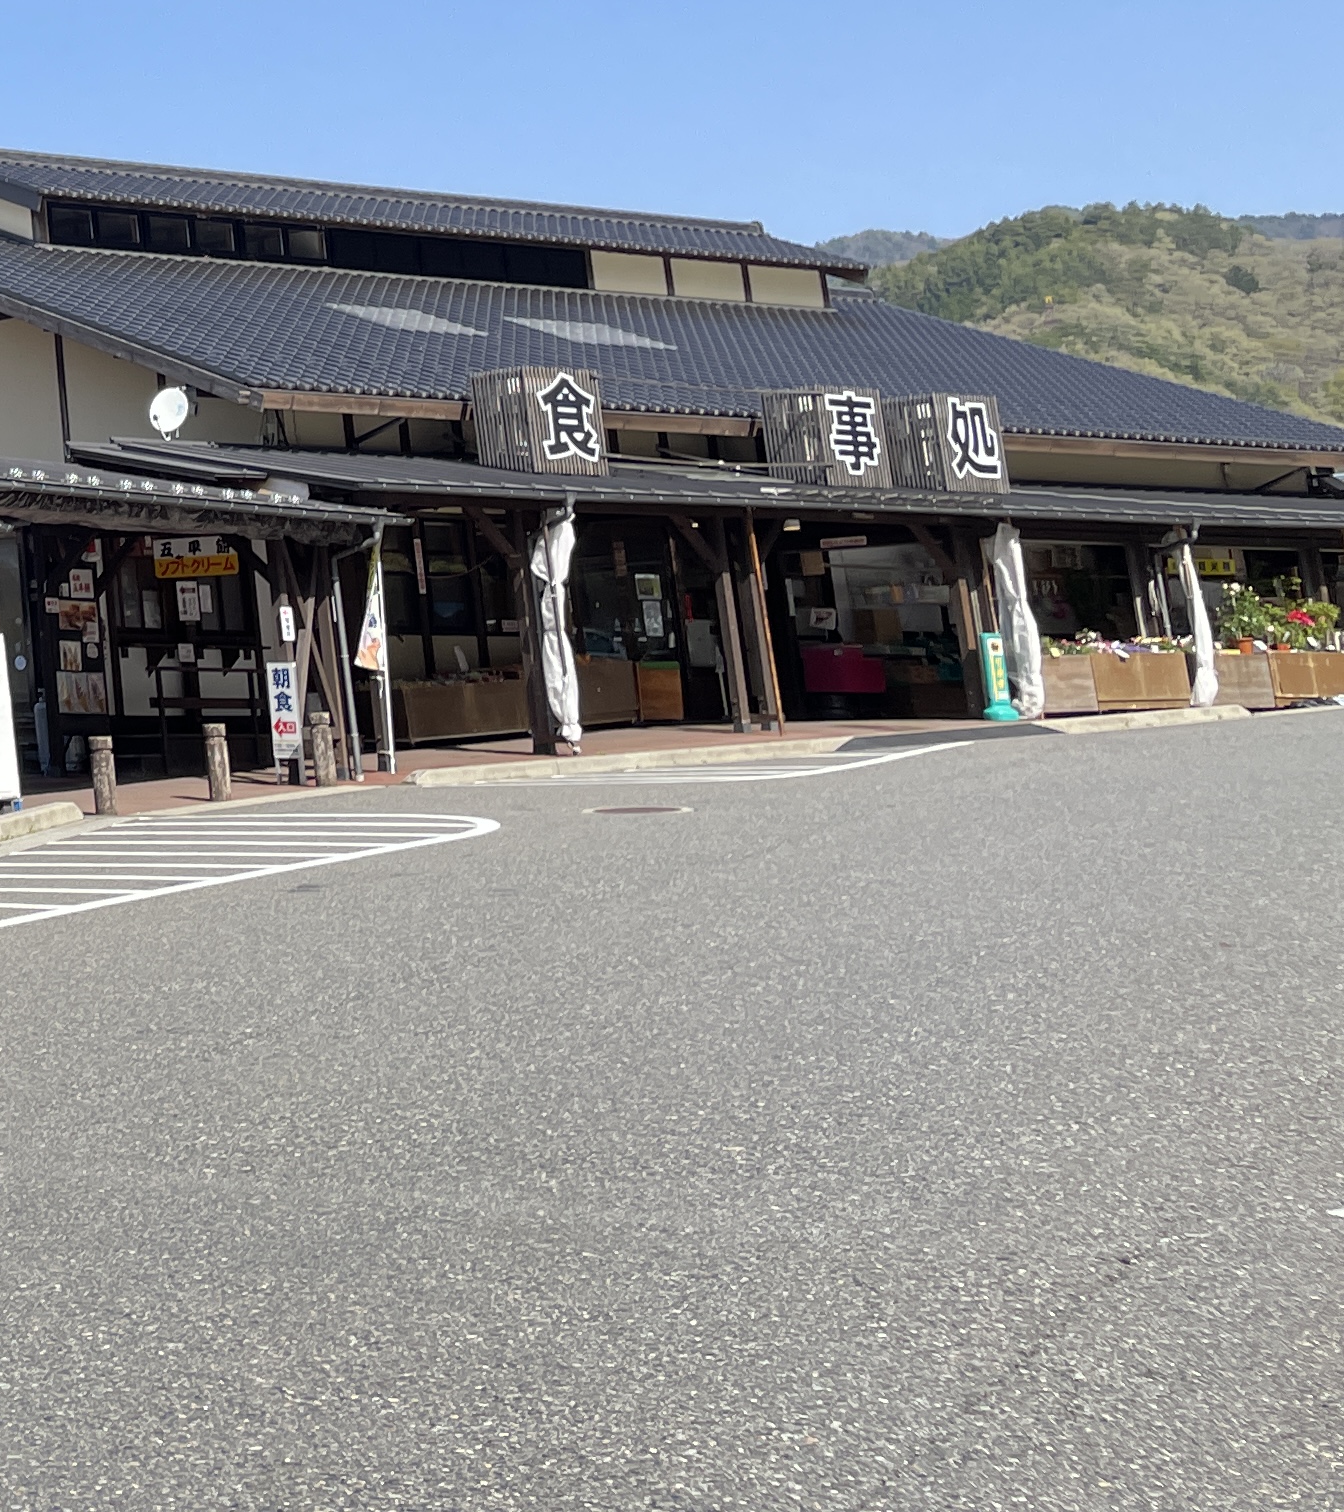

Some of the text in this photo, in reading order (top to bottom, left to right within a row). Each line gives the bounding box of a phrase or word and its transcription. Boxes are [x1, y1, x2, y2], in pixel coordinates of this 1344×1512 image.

[536, 371, 1002, 480] 食事処
[159, 556, 236, 576] ソフトクリーム
[271, 668, 294, 712] 朝食
[278, 722, 295, 733] 入口
